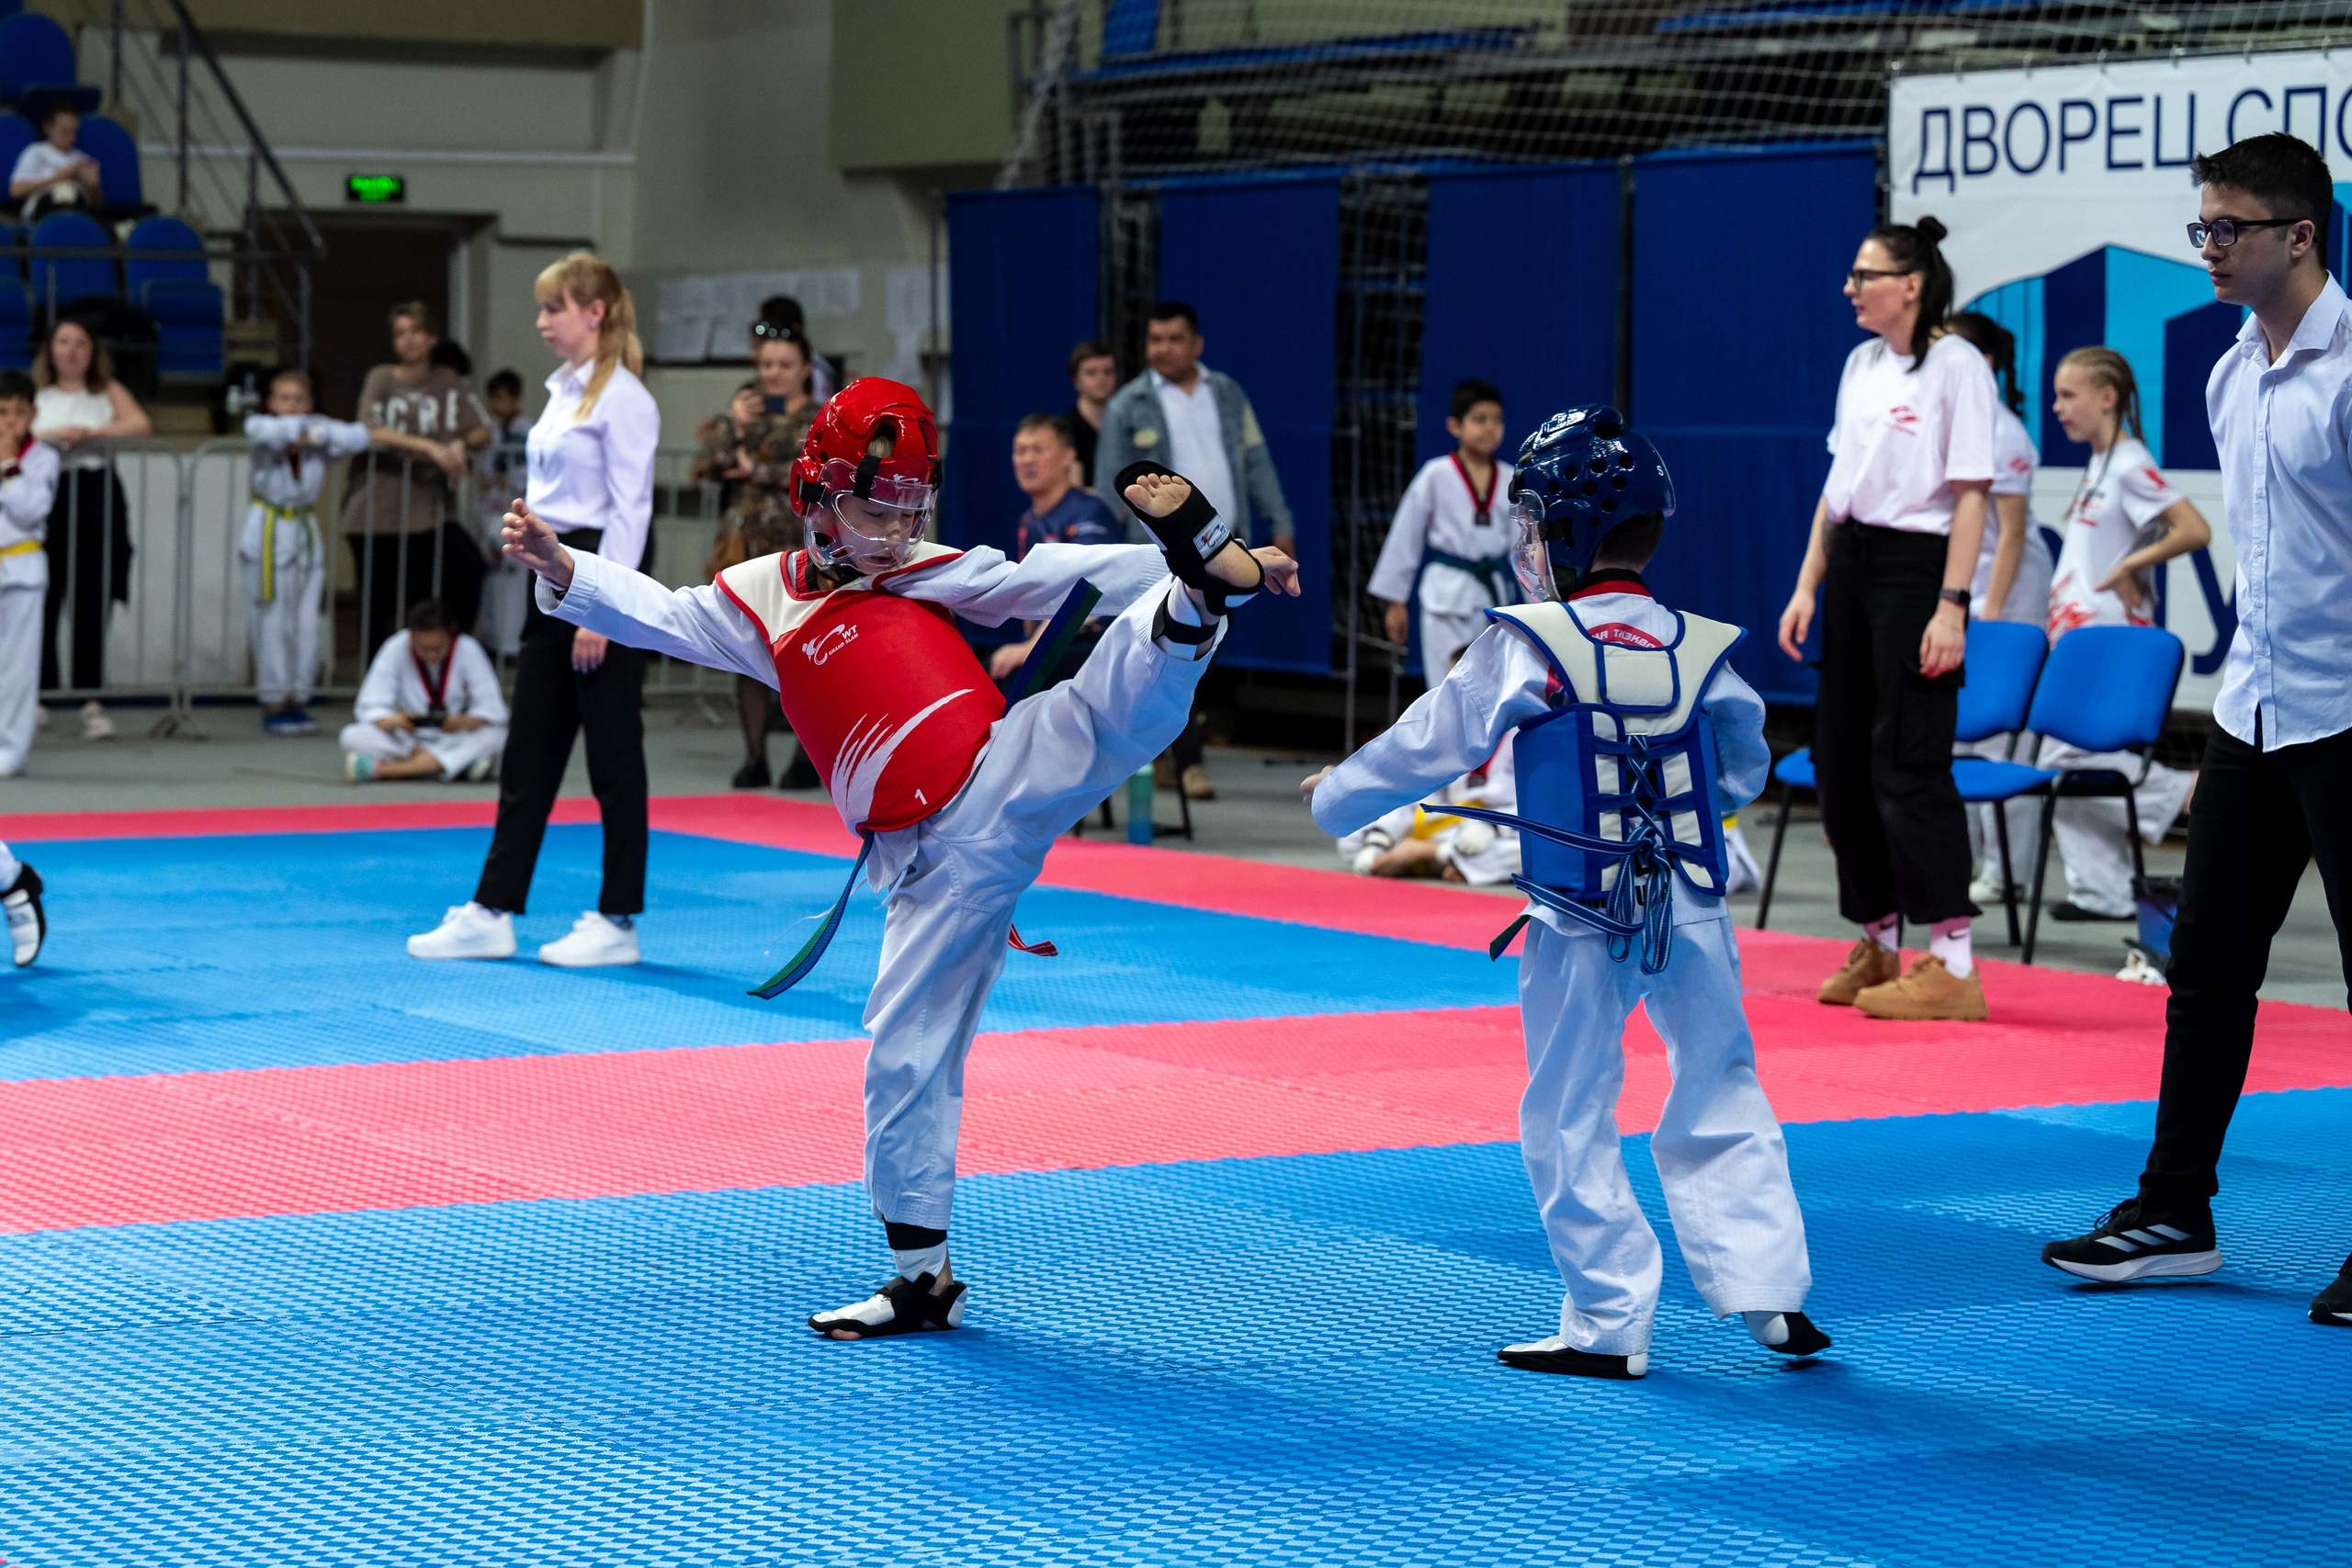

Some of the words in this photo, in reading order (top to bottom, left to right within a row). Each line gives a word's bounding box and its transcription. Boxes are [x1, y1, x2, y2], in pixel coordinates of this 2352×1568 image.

[1912, 91, 2199, 195] ДВОРЕЦ
[1656, 465, 1664, 477] S
[842, 624, 857, 639] WT
[829, 642, 844, 655] GRAND
[844, 632, 859, 645] SLAM
[914, 788, 928, 806] 1
